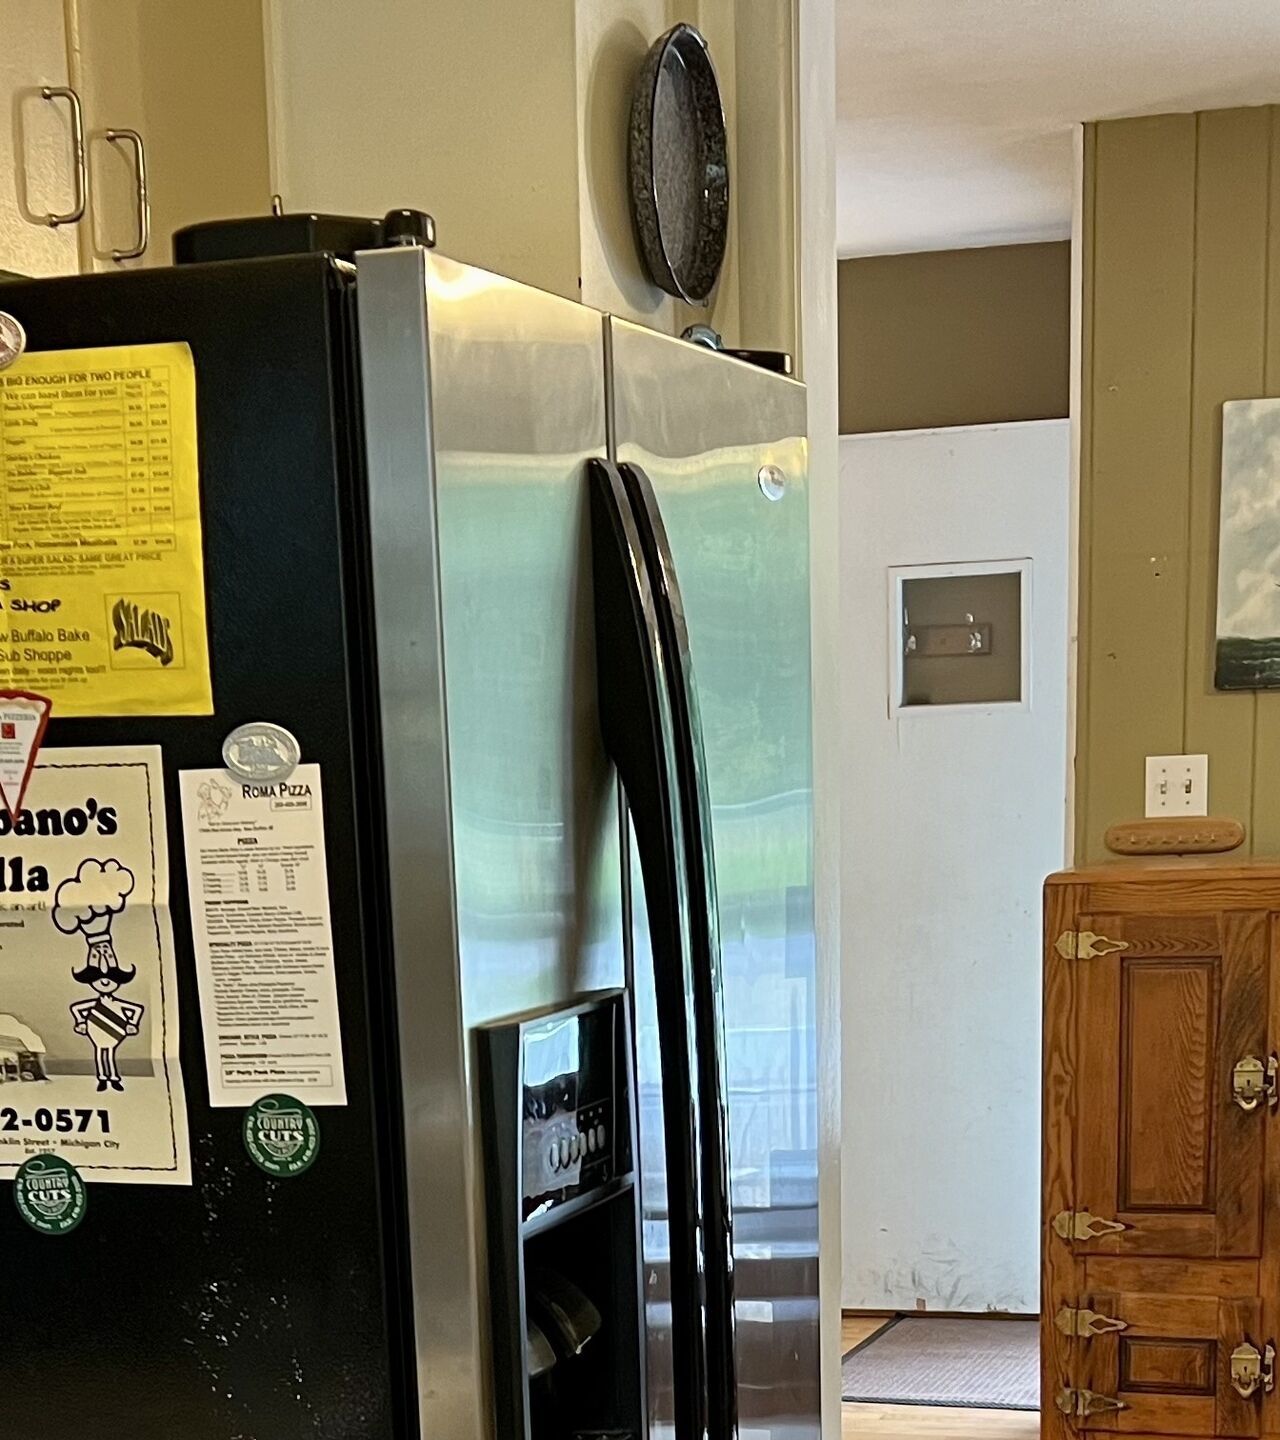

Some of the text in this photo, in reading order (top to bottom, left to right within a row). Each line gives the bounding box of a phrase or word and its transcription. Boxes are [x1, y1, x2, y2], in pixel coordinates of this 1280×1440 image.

[7, 377, 22, 387] BIG
[25, 375, 66, 385] ENOUGH
[69, 373, 86, 384] FOR
[91, 372, 111, 382] TWO
[114, 368, 151, 380] PEOPLE
[105, 553, 133, 563] GREAT
[11, 599, 62, 613] SHOP
[11, 629, 54, 643] Buffalo
[58, 628, 90, 642] Bake
[24, 648, 72, 664] Shoppe
[242, 782, 312, 799] ROMA PIZZA
[257, 1117, 303, 1130] COUNTRY
[258, 1130, 304, 1141] CUTS
[23, 1138, 50, 1146] Street
[60, 1139, 101, 1149] Michigan
[104, 1140, 120, 1149] City
[26, 1177, 70, 1191] COUNTRY
[28, 1189, 72, 1202] CUTS
